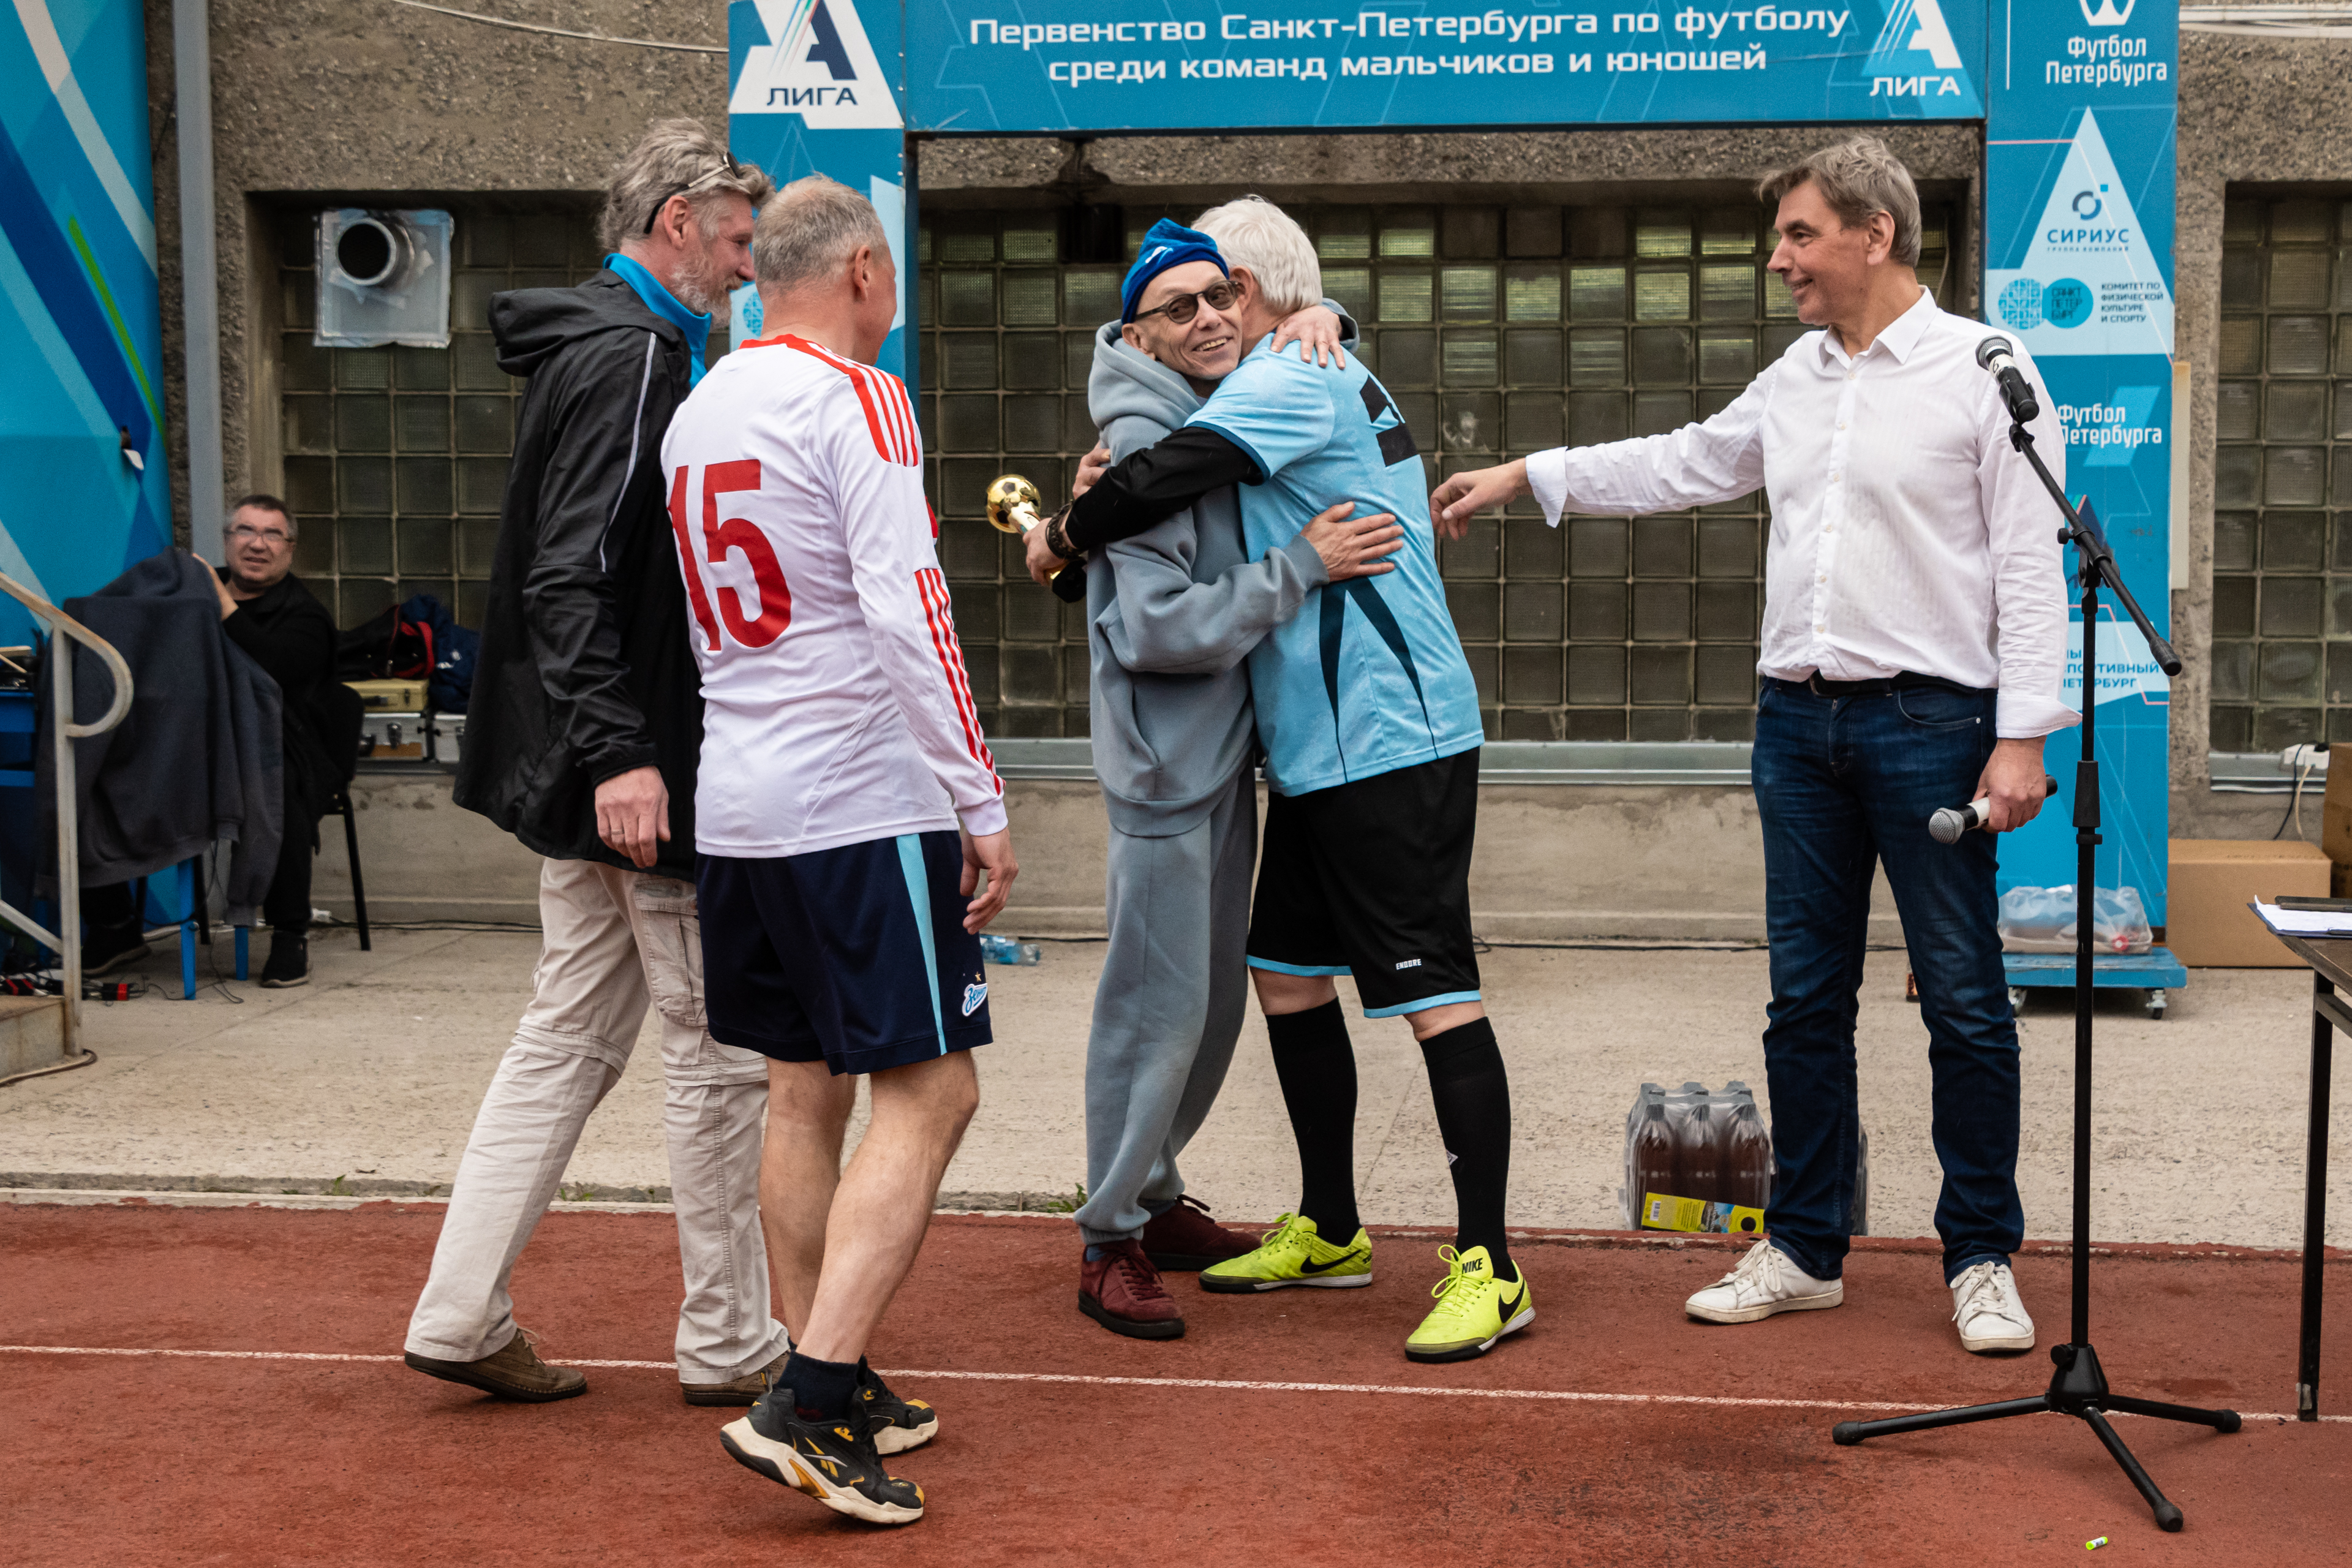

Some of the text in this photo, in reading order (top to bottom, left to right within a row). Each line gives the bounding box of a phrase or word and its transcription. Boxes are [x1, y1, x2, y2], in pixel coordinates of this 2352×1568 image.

[971, 6, 1849, 50] Первенство Санкт-Петербурга по футболу
[2068, 34, 2146, 63] Футбол
[1049, 43, 1766, 88] среди команд мальчиков и юношей
[2046, 59, 2167, 88] Петербурга
[1869, 76, 1961, 96] ЛИГА
[767, 87, 858, 106] ЛИГА
[2047, 228, 2129, 243] СИРИУС
[2101, 282, 2160, 291] КОМИТЕТ ПО
[2101, 292, 2163, 301] ФИЗИЧЕСКОЙ
[2101, 304, 2144, 312] КУЛЬТУРЕ
[2109, 314, 2147, 323] СПОРТУ
[2057, 403, 2126, 428] Футбол
[666, 459, 791, 651] 15
[2063, 678, 2137, 688] ЕТРБУРГ
[1462, 1257, 1483, 1275] NIKE
